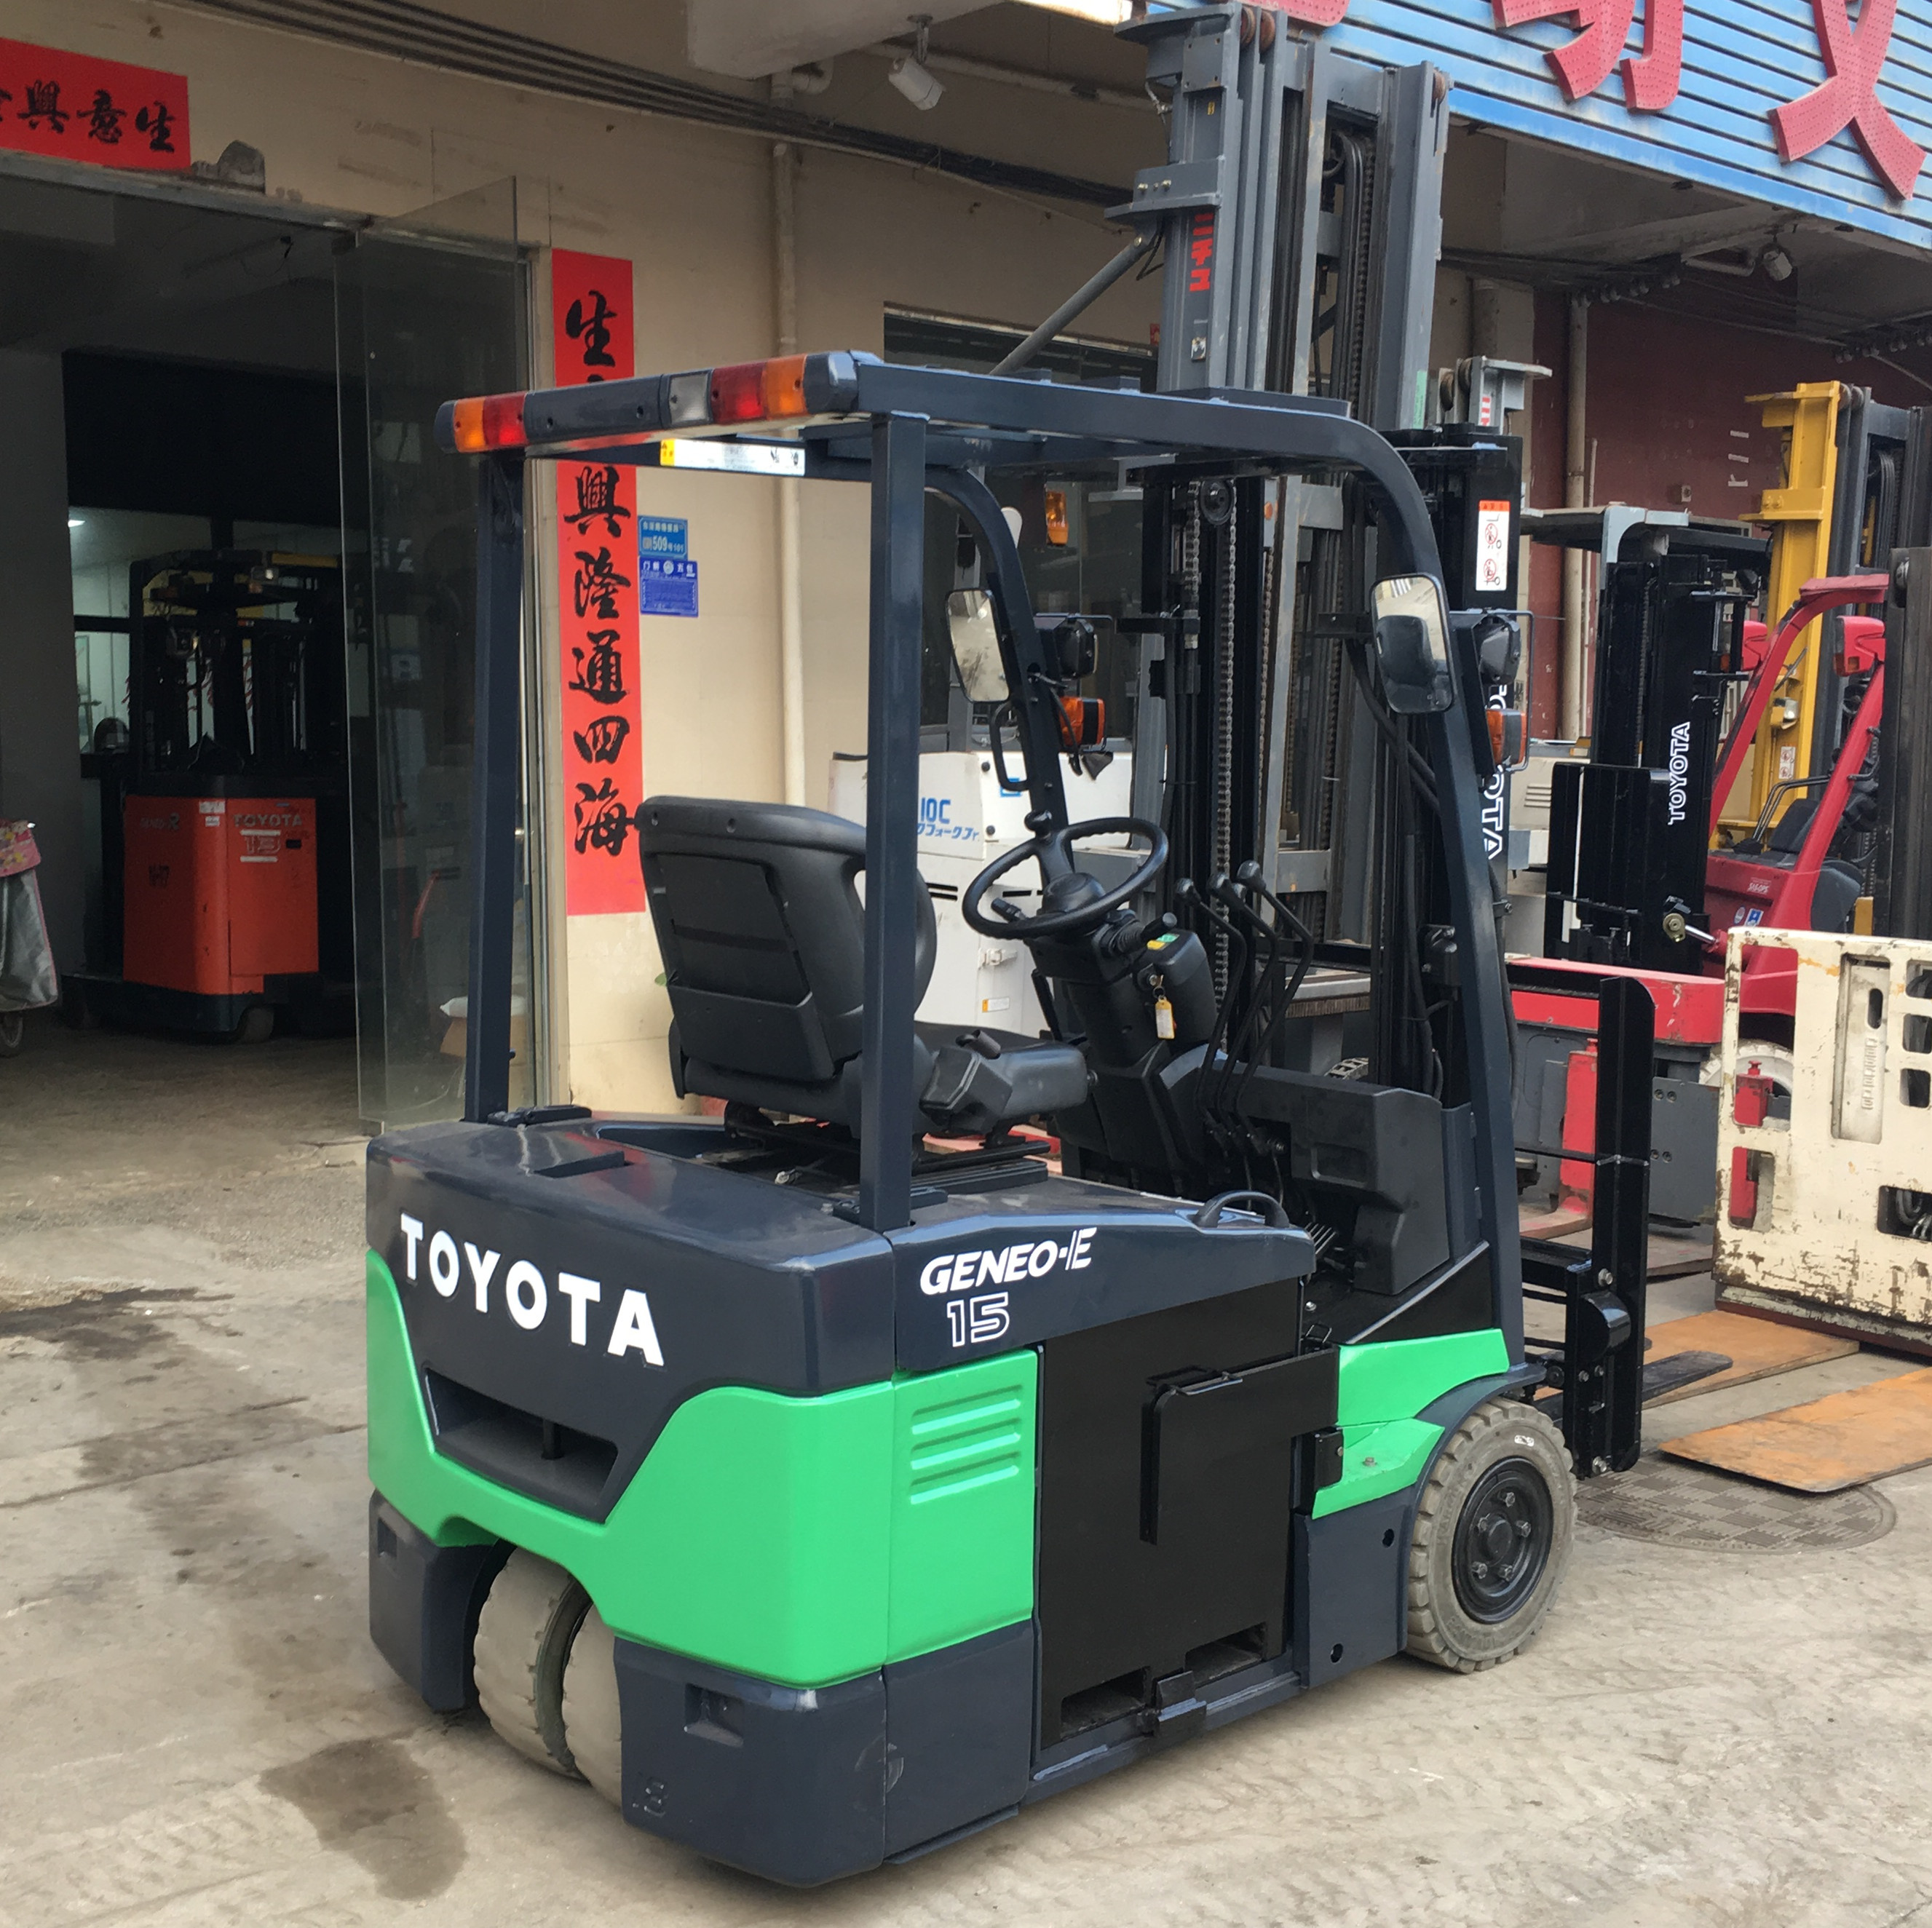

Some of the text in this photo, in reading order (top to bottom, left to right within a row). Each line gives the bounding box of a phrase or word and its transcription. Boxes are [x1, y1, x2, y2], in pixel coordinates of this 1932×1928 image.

[564, 290, 635, 857] 生興隆通四海
[233, 813, 303, 828] TOYOTA
[1481, 677, 1506, 860] OTA
[1668, 721, 1691, 825] TOYOTA
[401, 1213, 664, 1367] TOYOTA
[920, 1227, 1098, 1296] GENEO-E
[946, 1291, 1010, 1348] 15
